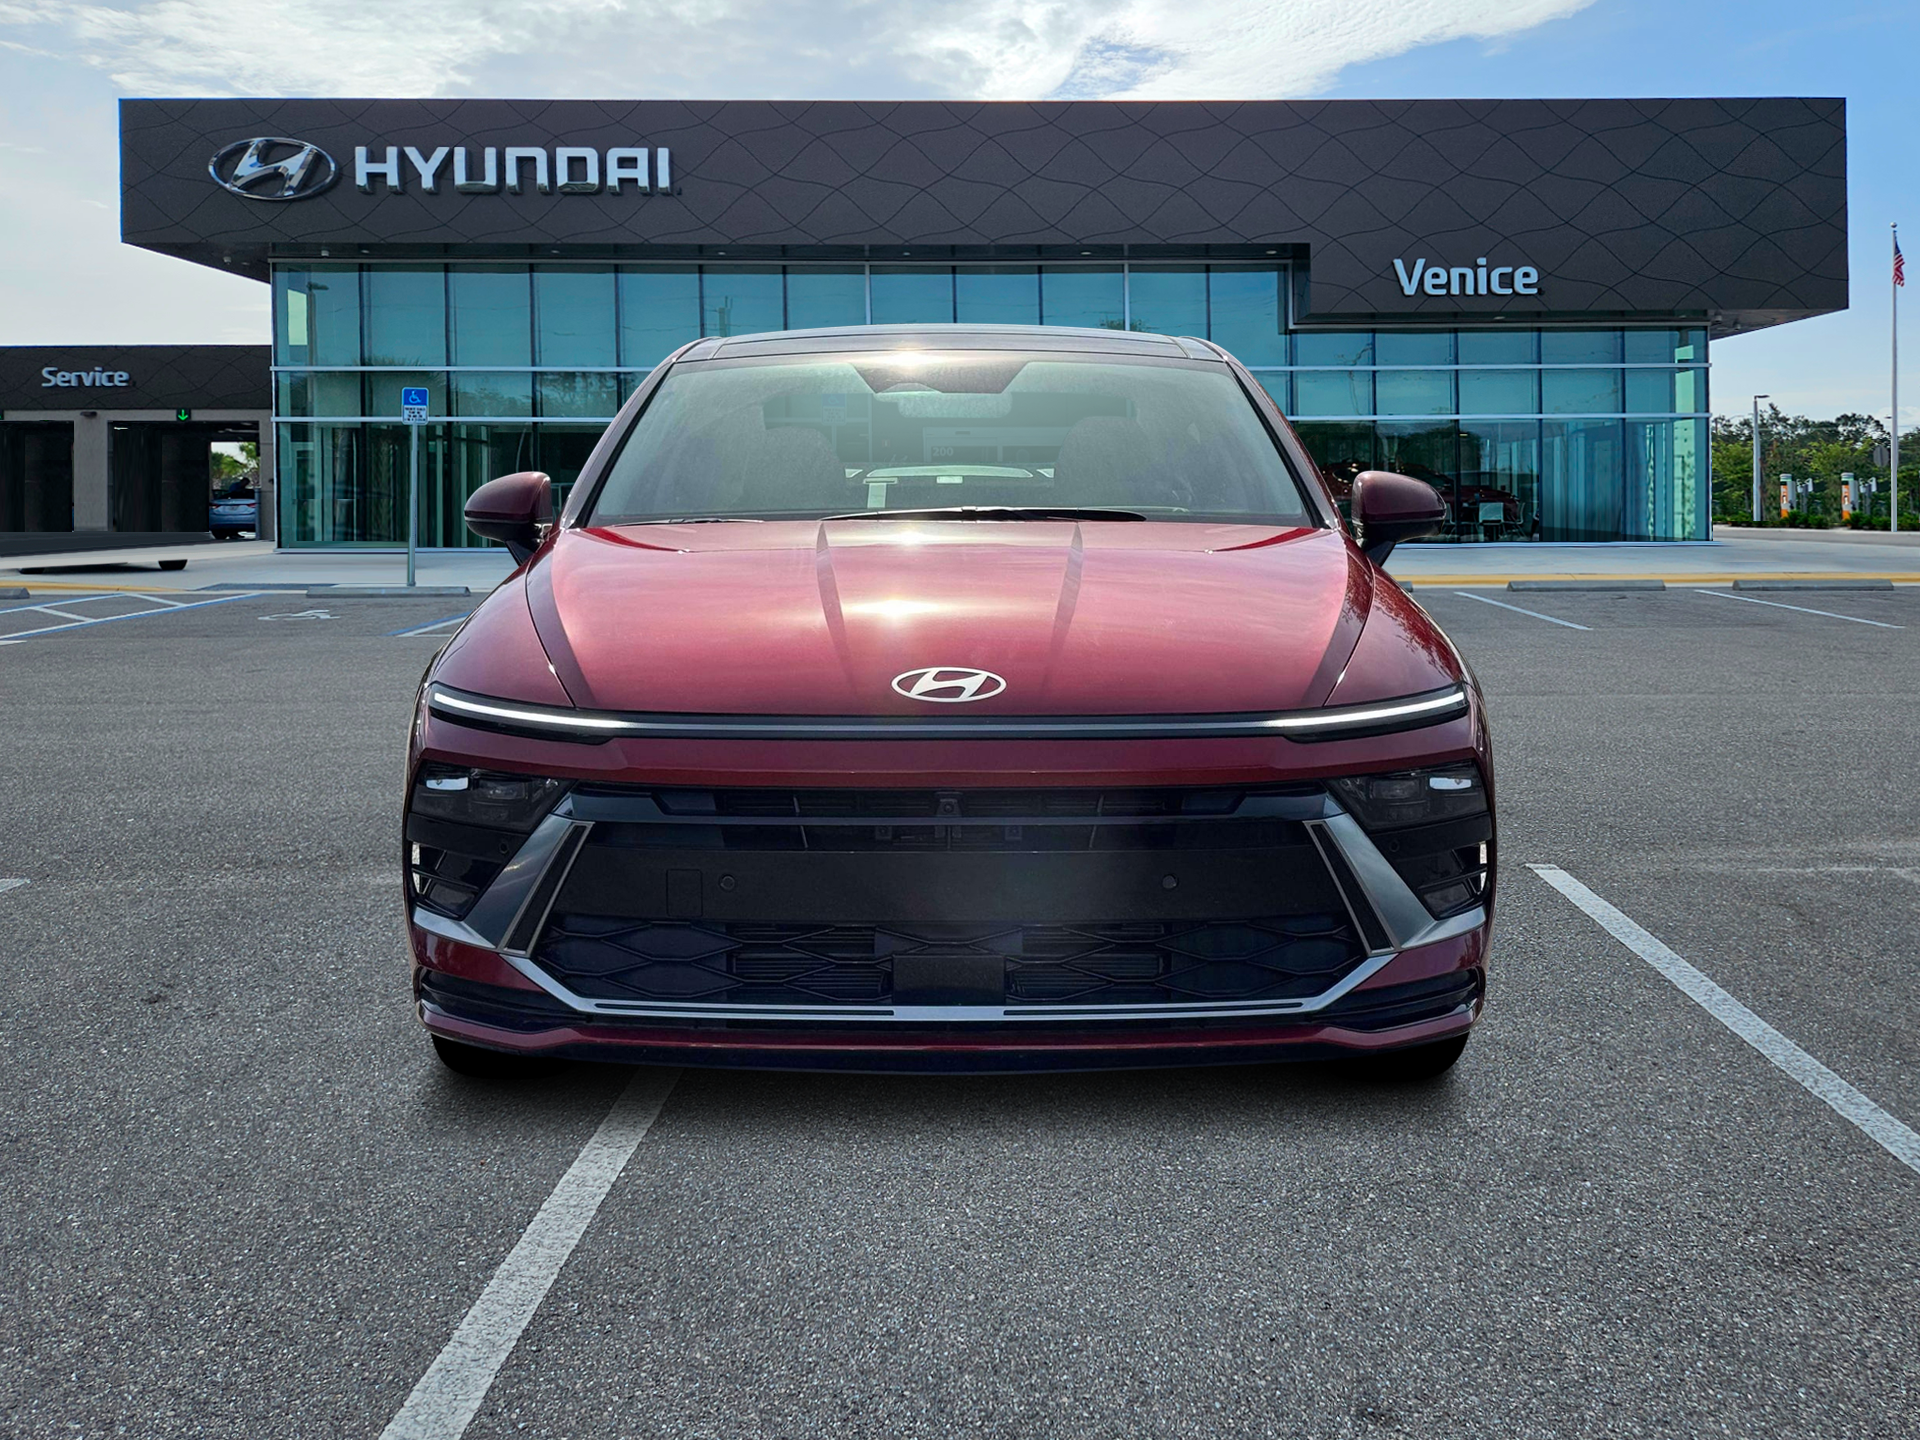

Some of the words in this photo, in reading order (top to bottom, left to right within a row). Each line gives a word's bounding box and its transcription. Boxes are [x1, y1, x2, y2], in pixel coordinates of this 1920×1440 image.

[354, 146, 671, 194] HYUNDAI
[1393, 257, 1539, 296] Venice
[41, 366, 130, 387] Service
[932, 446, 954, 457] 200
